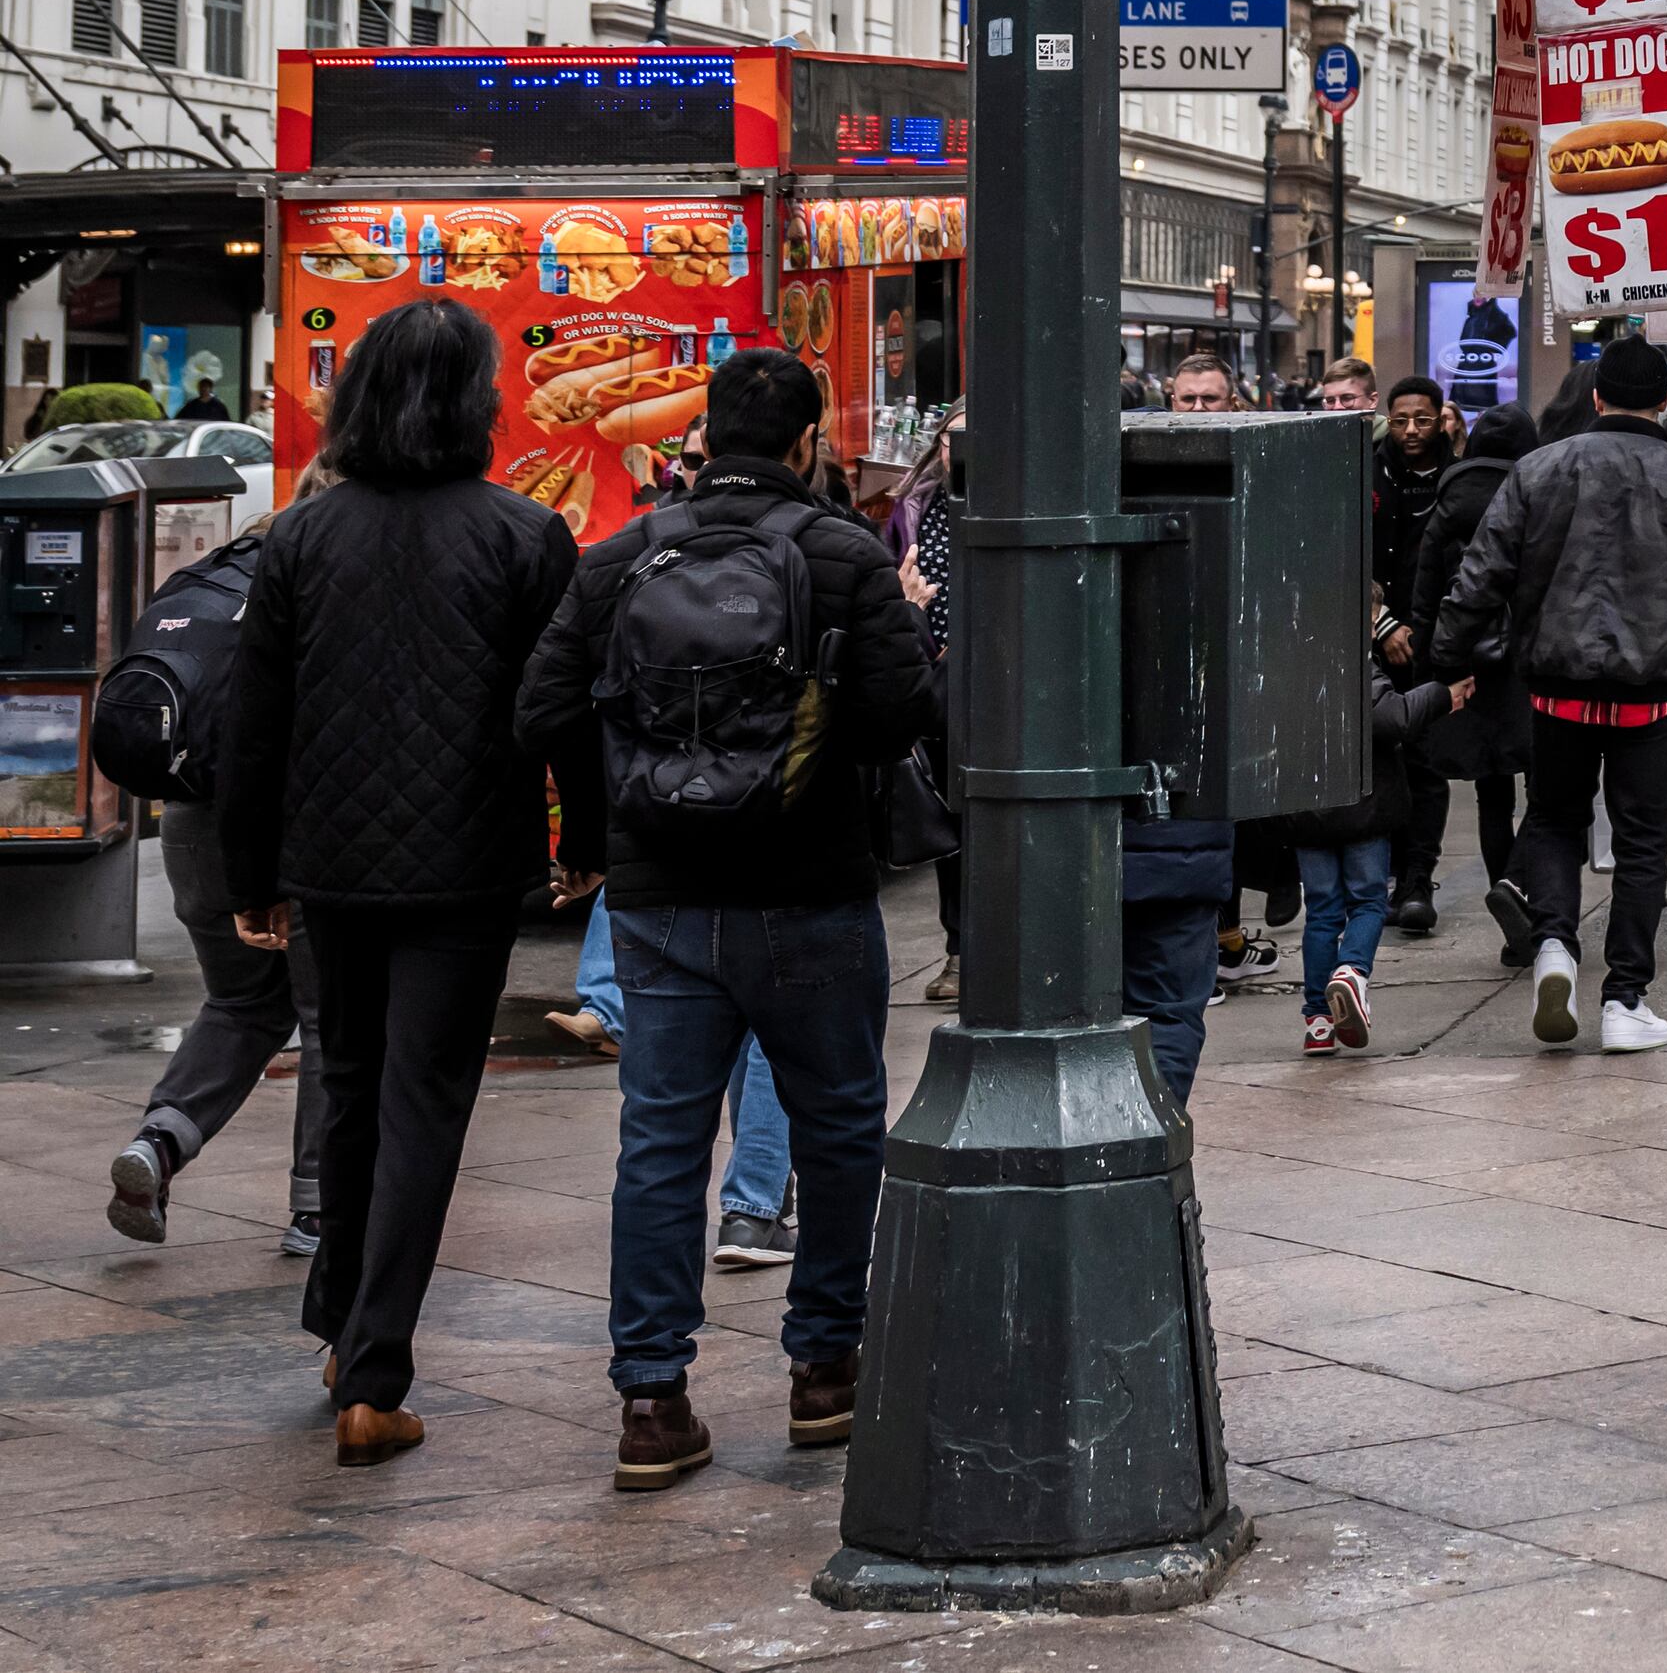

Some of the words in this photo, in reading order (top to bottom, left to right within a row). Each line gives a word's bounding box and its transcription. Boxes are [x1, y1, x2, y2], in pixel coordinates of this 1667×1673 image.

[1127, 1, 1187, 21] LANE
[1056, 59, 1071, 68] 127
[1179, 45, 1253, 71] ONLY
[1547, 40, 1608, 86] HOT
[540, 207, 567, 235] CHICKEN
[1586, 289, 1610, 305] K+M
[311, 308, 327, 329] 6
[580, 311, 605, 324] DOG
[645, 316, 675, 332] SODA
[531, 325, 545, 346] 5
[563, 329, 581, 340] OR
[581, 325, 619, 336] WATER
[505, 455, 529, 475] CORN
[529, 447, 549, 460] DOG
[711, 474, 757, 486] NAUTICA
